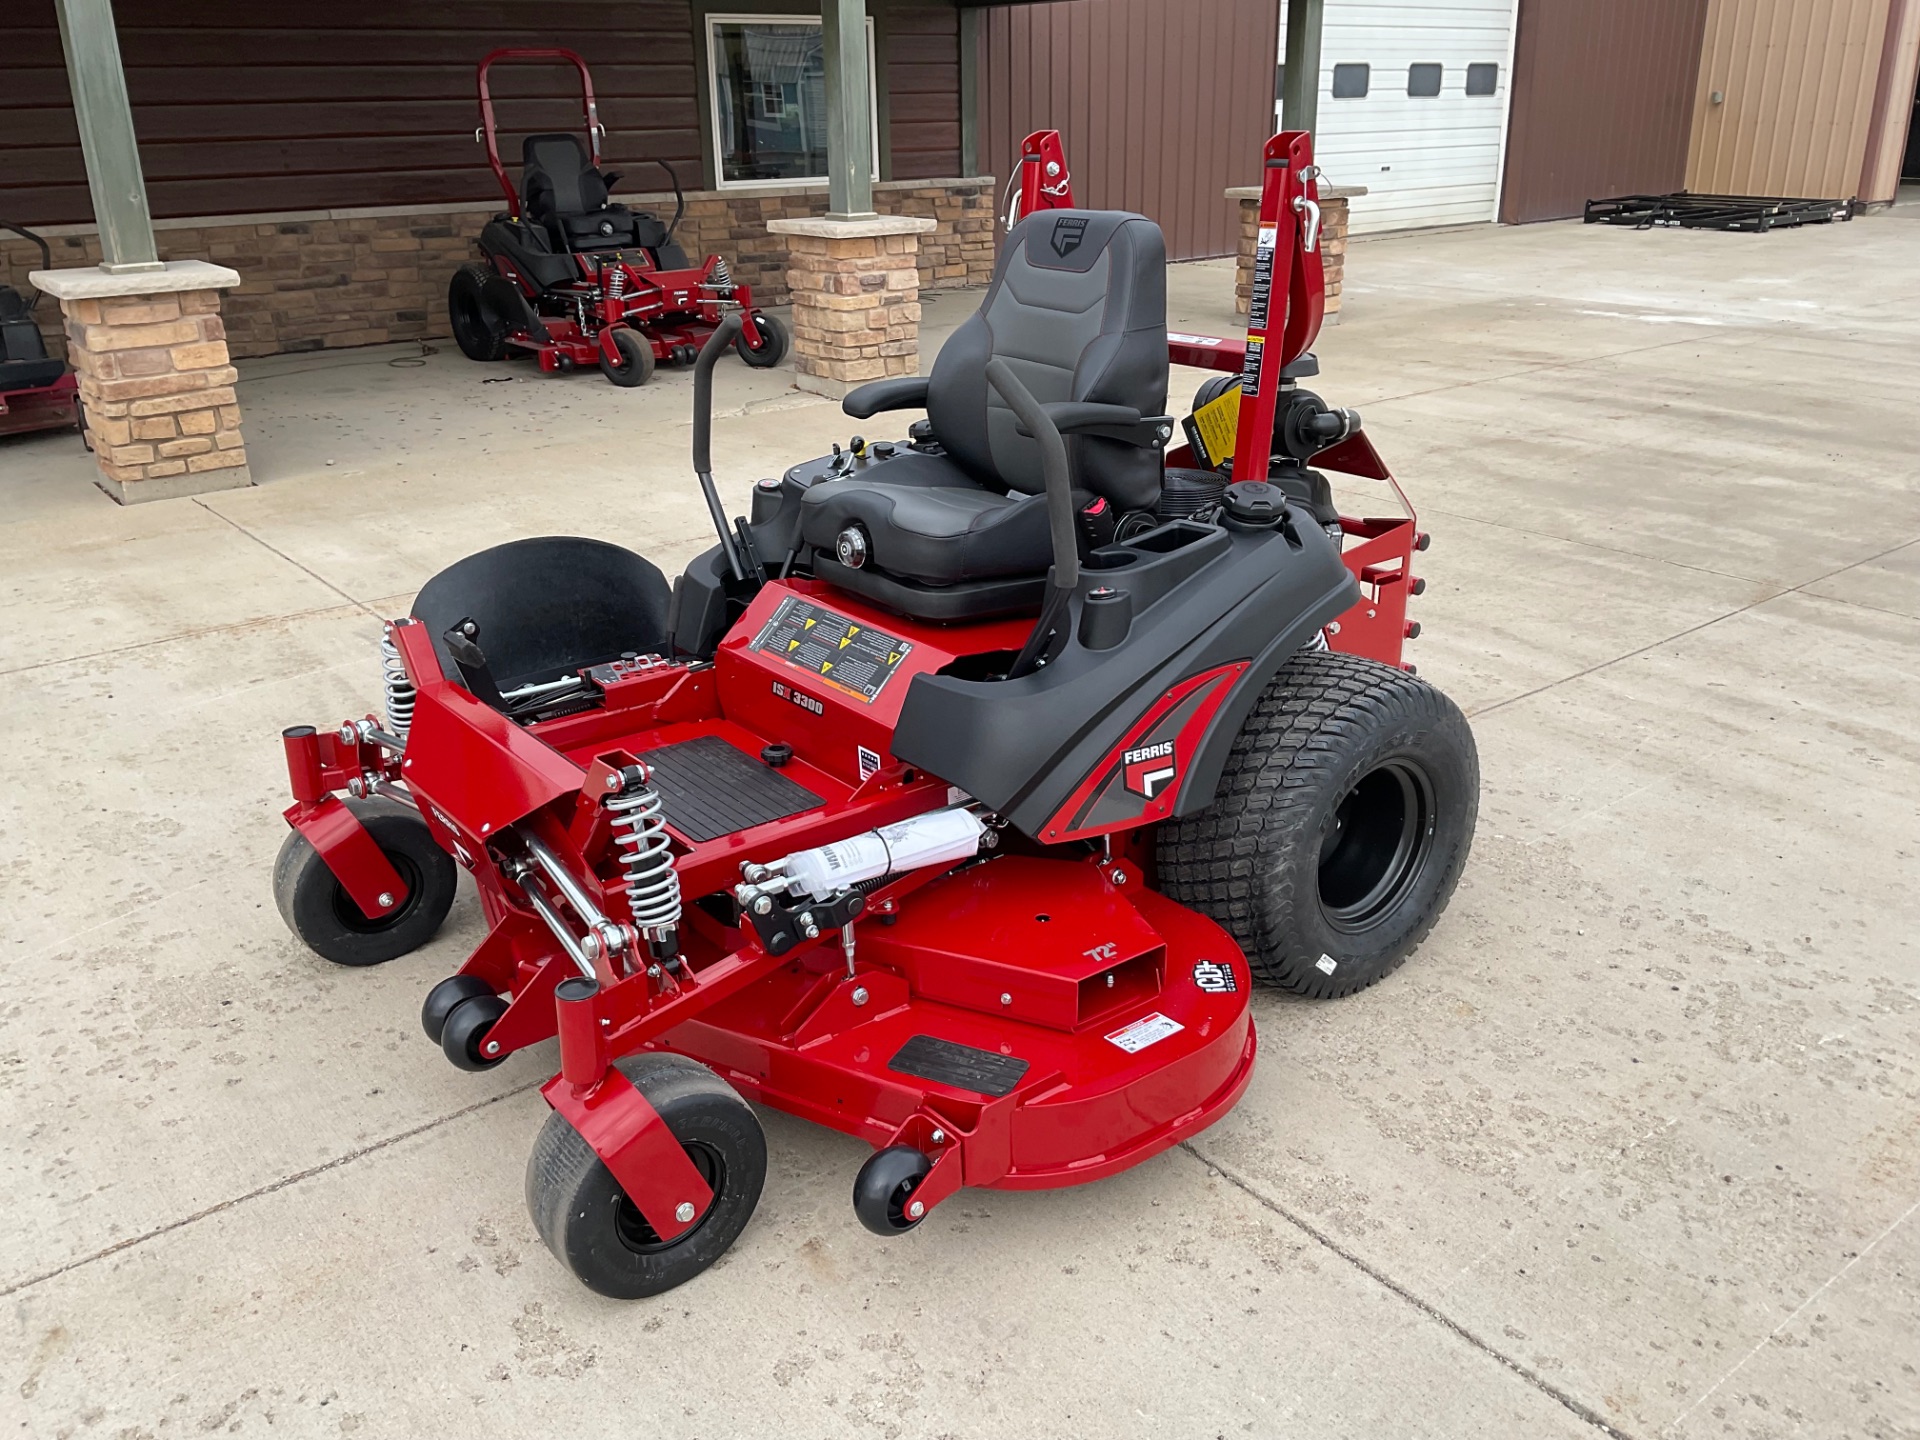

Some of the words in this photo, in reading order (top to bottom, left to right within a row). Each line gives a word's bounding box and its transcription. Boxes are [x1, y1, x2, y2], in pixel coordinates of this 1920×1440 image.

[1058, 219, 1087, 227] FERRIS
[793, 691, 823, 715] 3300
[1124, 741, 1173, 764] FERRIS
